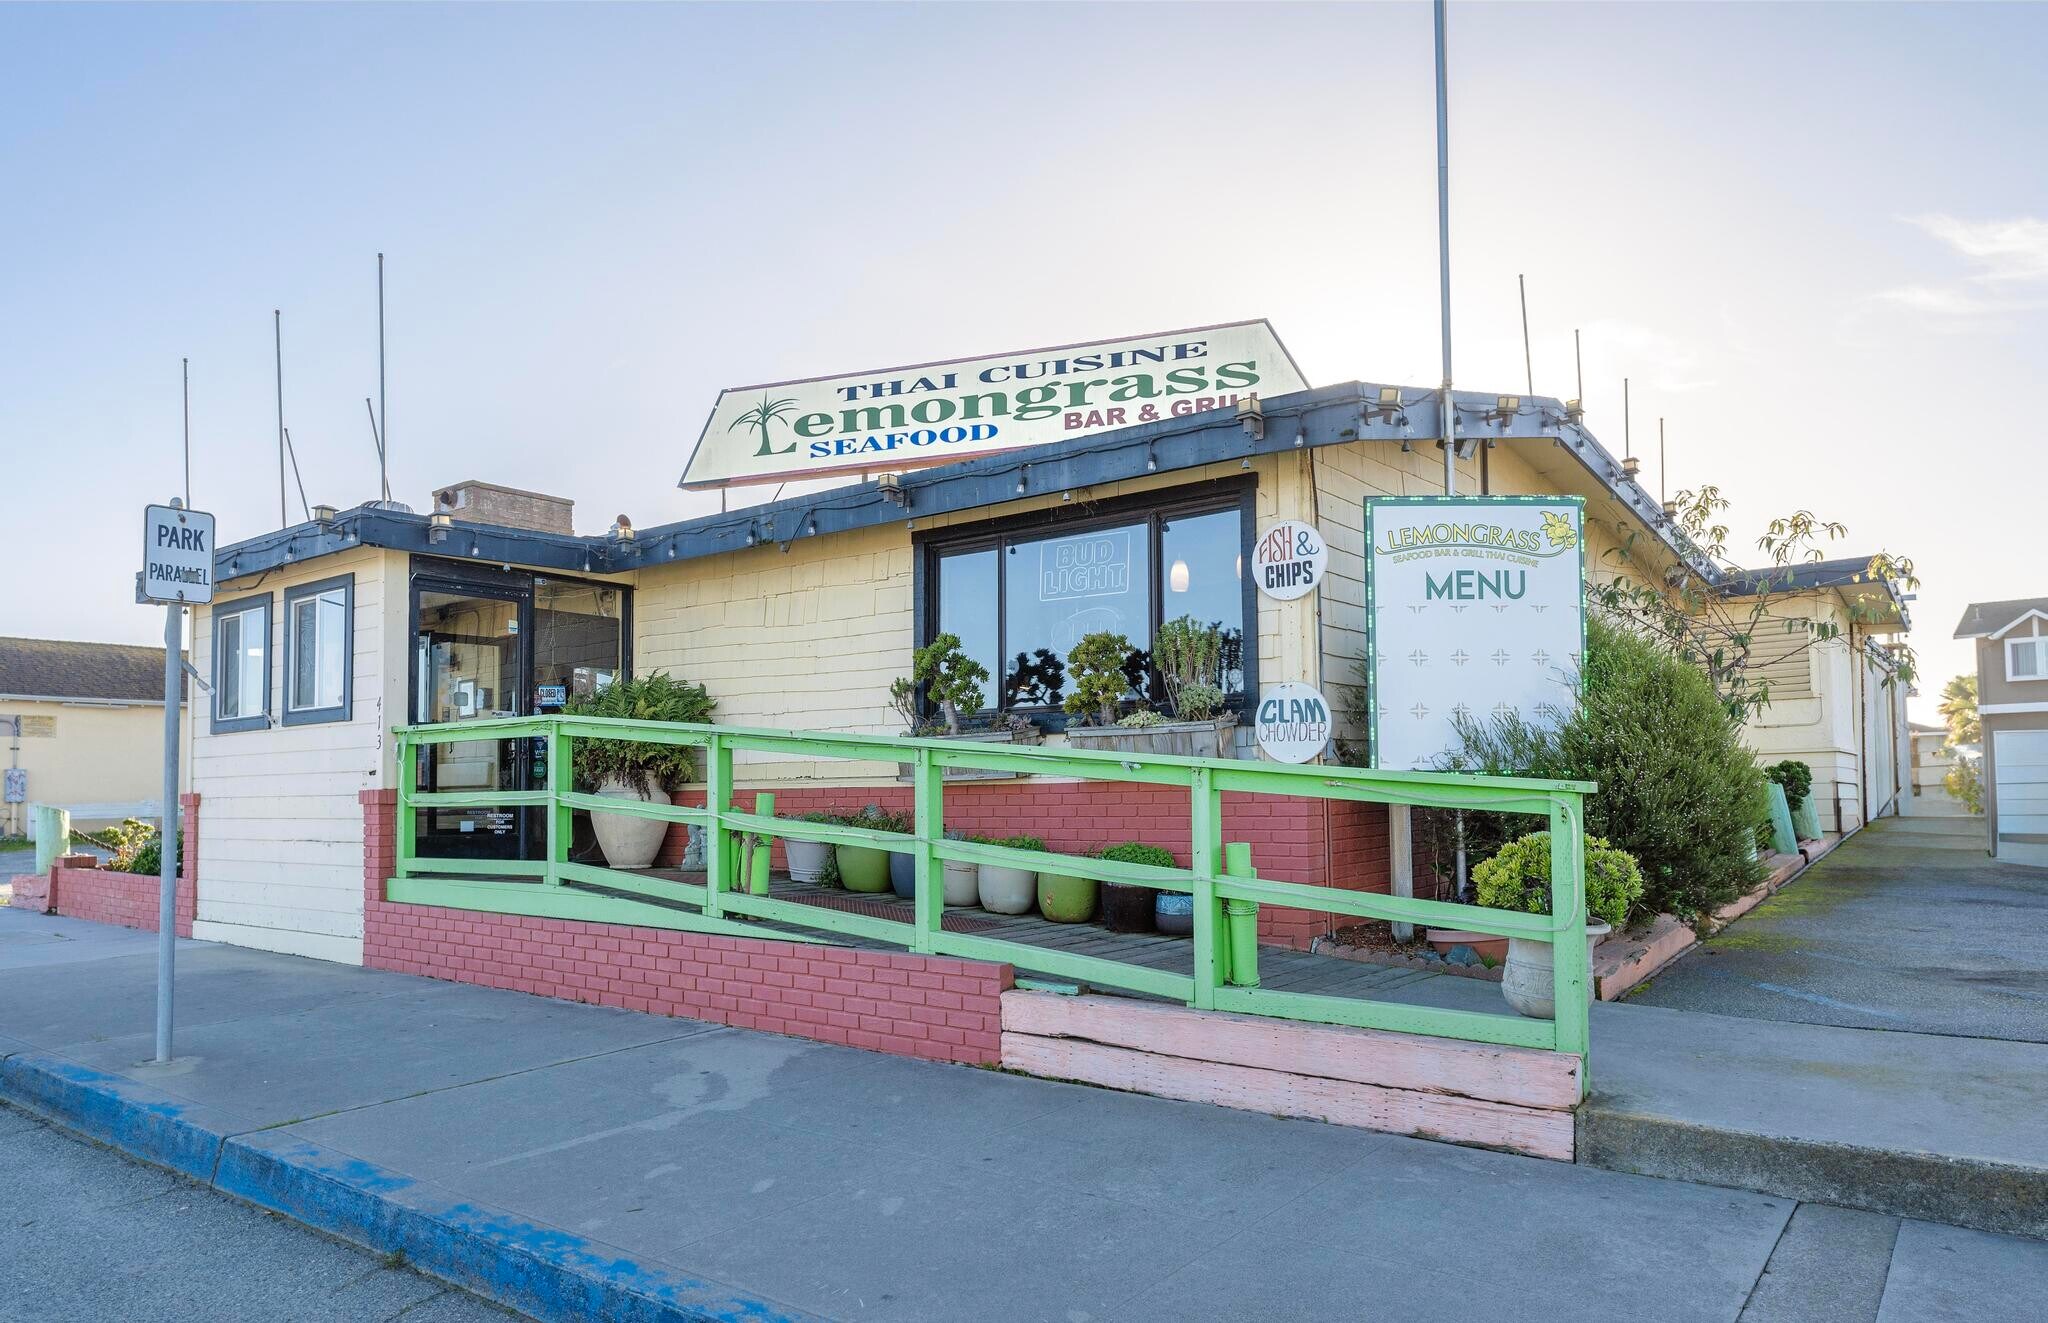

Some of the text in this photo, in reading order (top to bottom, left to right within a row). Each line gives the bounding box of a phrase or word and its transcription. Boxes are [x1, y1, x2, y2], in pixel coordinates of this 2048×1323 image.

[837, 341, 1208, 402] THAI CUISINE
[727, 360, 1261, 457] Lemongrass
[1064, 407, 1127, 430] BAR
[1137, 403, 1161, 422] &
[809, 423, 999, 459] SEAFOOD
[157, 523, 205, 553] PARK
[1259, 526, 1320, 564] FISH &
[1387, 523, 1541, 551] LEMONGRASS
[1056, 539, 1114, 569] BUD
[1392, 549, 1433, 565] SEAFOOD
[1434, 548, 1451, 558] BAR
[1461, 548, 1485, 559] GRILL
[1485, 550, 1505, 561] THAI
[1506, 554, 1540, 569] CUISINE
[1044, 563, 1126, 595] LIGHT
[1265, 560, 1313, 589] CHIPS
[1425, 570, 1526, 600] MENU
[1259, 698, 1327, 724] CLAM
[1259, 721, 1327, 743] CHOWDER
